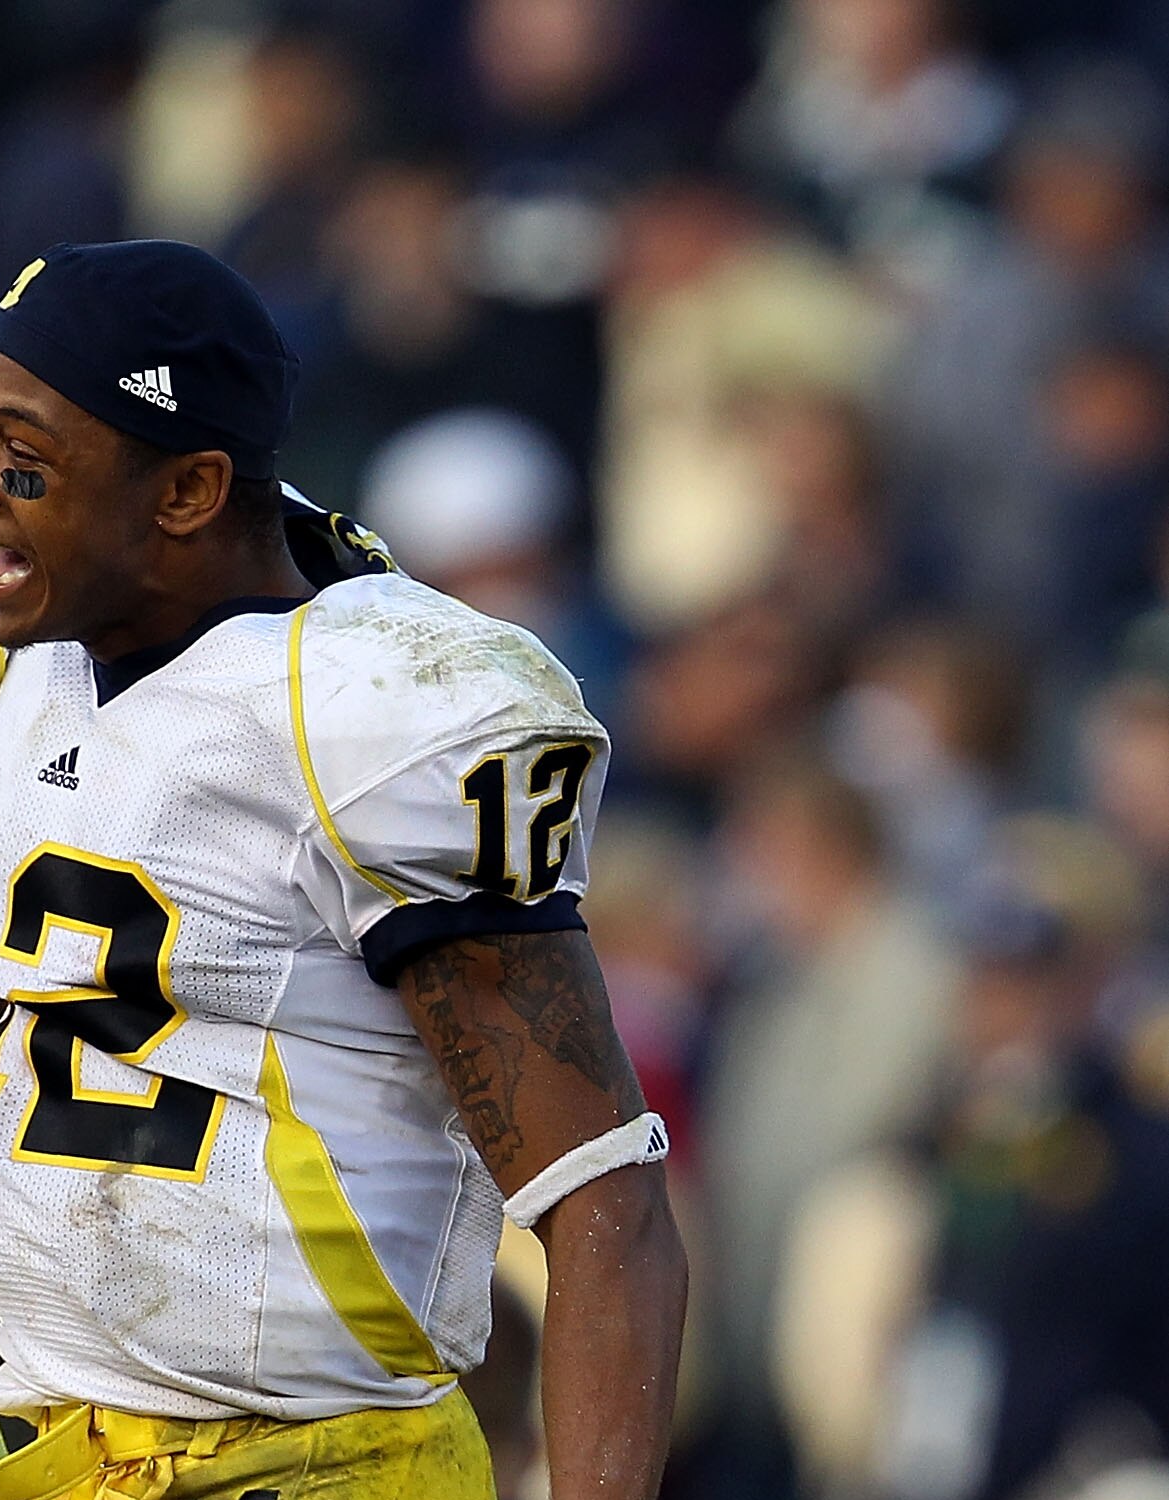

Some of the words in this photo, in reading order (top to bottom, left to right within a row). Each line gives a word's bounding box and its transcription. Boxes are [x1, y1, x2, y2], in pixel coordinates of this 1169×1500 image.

[118, 376, 178, 412] adidas
[38, 768, 80, 791] adidas
[456, 741, 595, 900] 12
